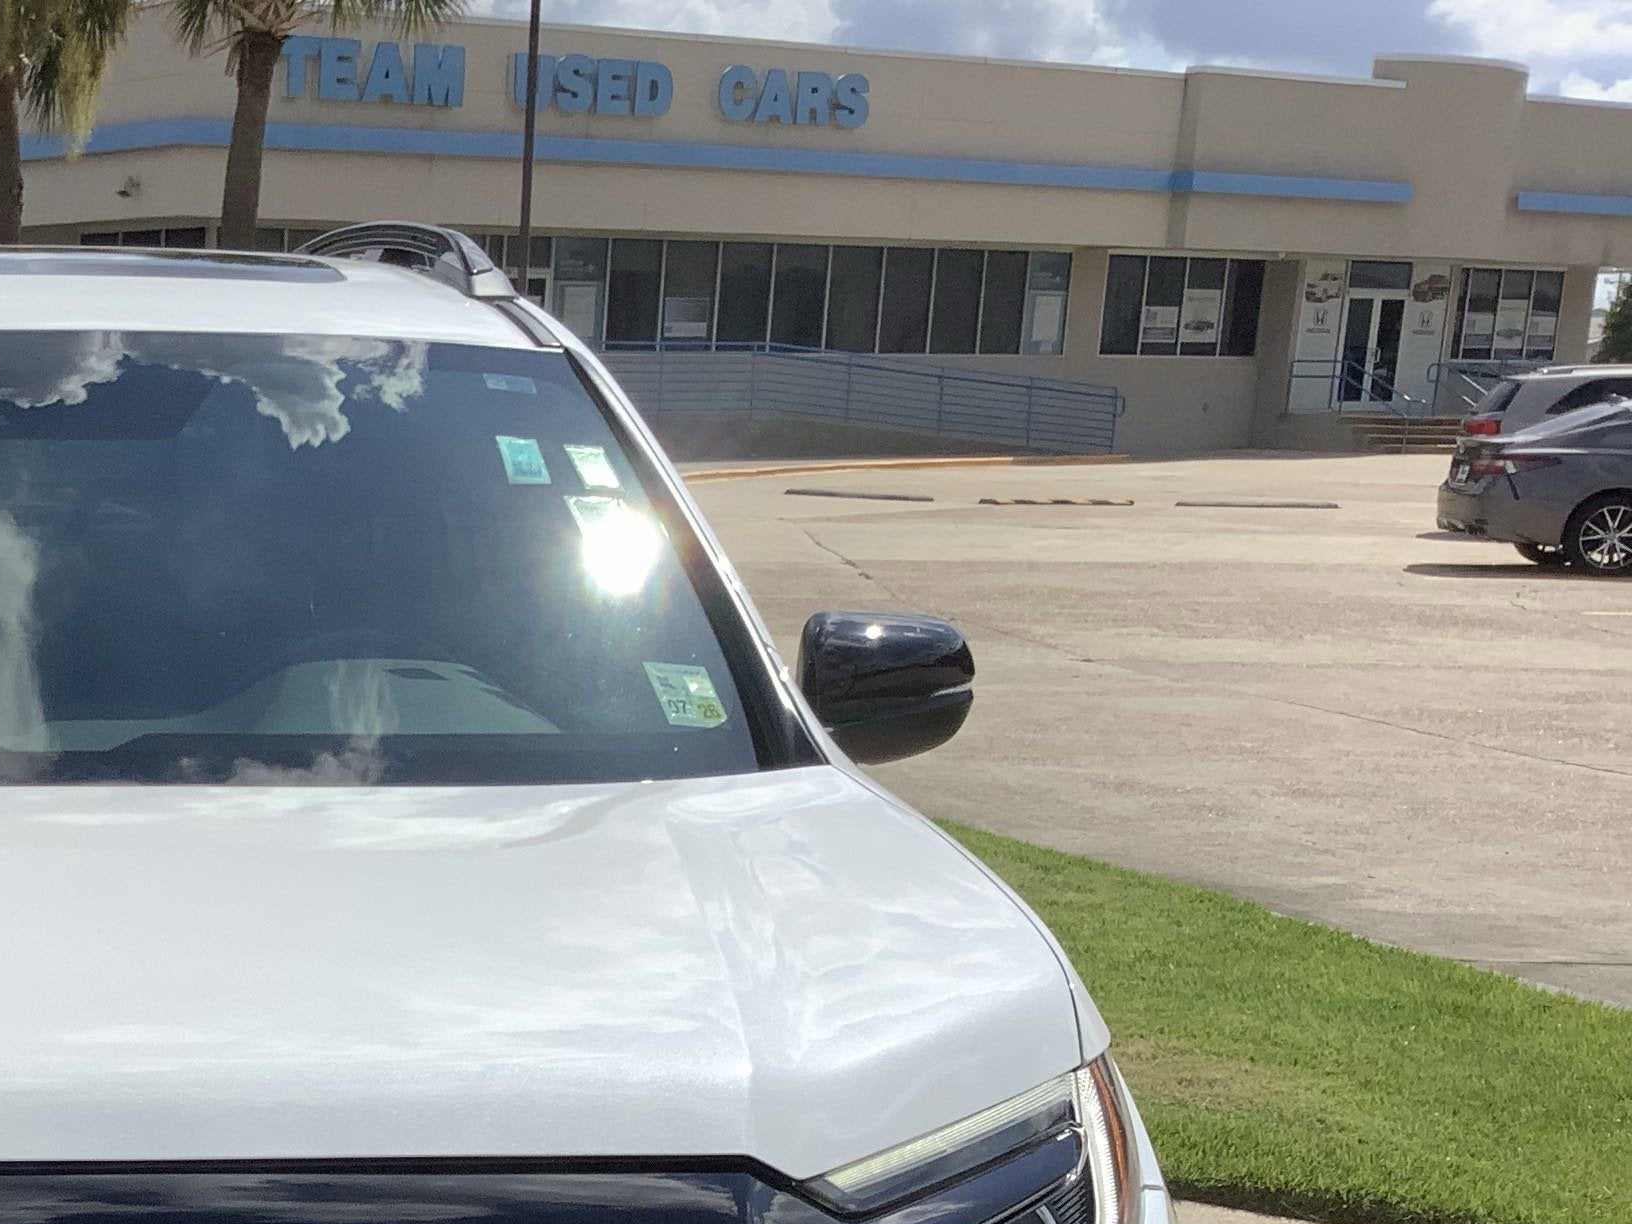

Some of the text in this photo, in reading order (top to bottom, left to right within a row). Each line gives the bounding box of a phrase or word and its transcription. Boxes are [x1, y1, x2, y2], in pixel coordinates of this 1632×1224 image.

[280, 35, 871, 129] TEAM USED CARS
